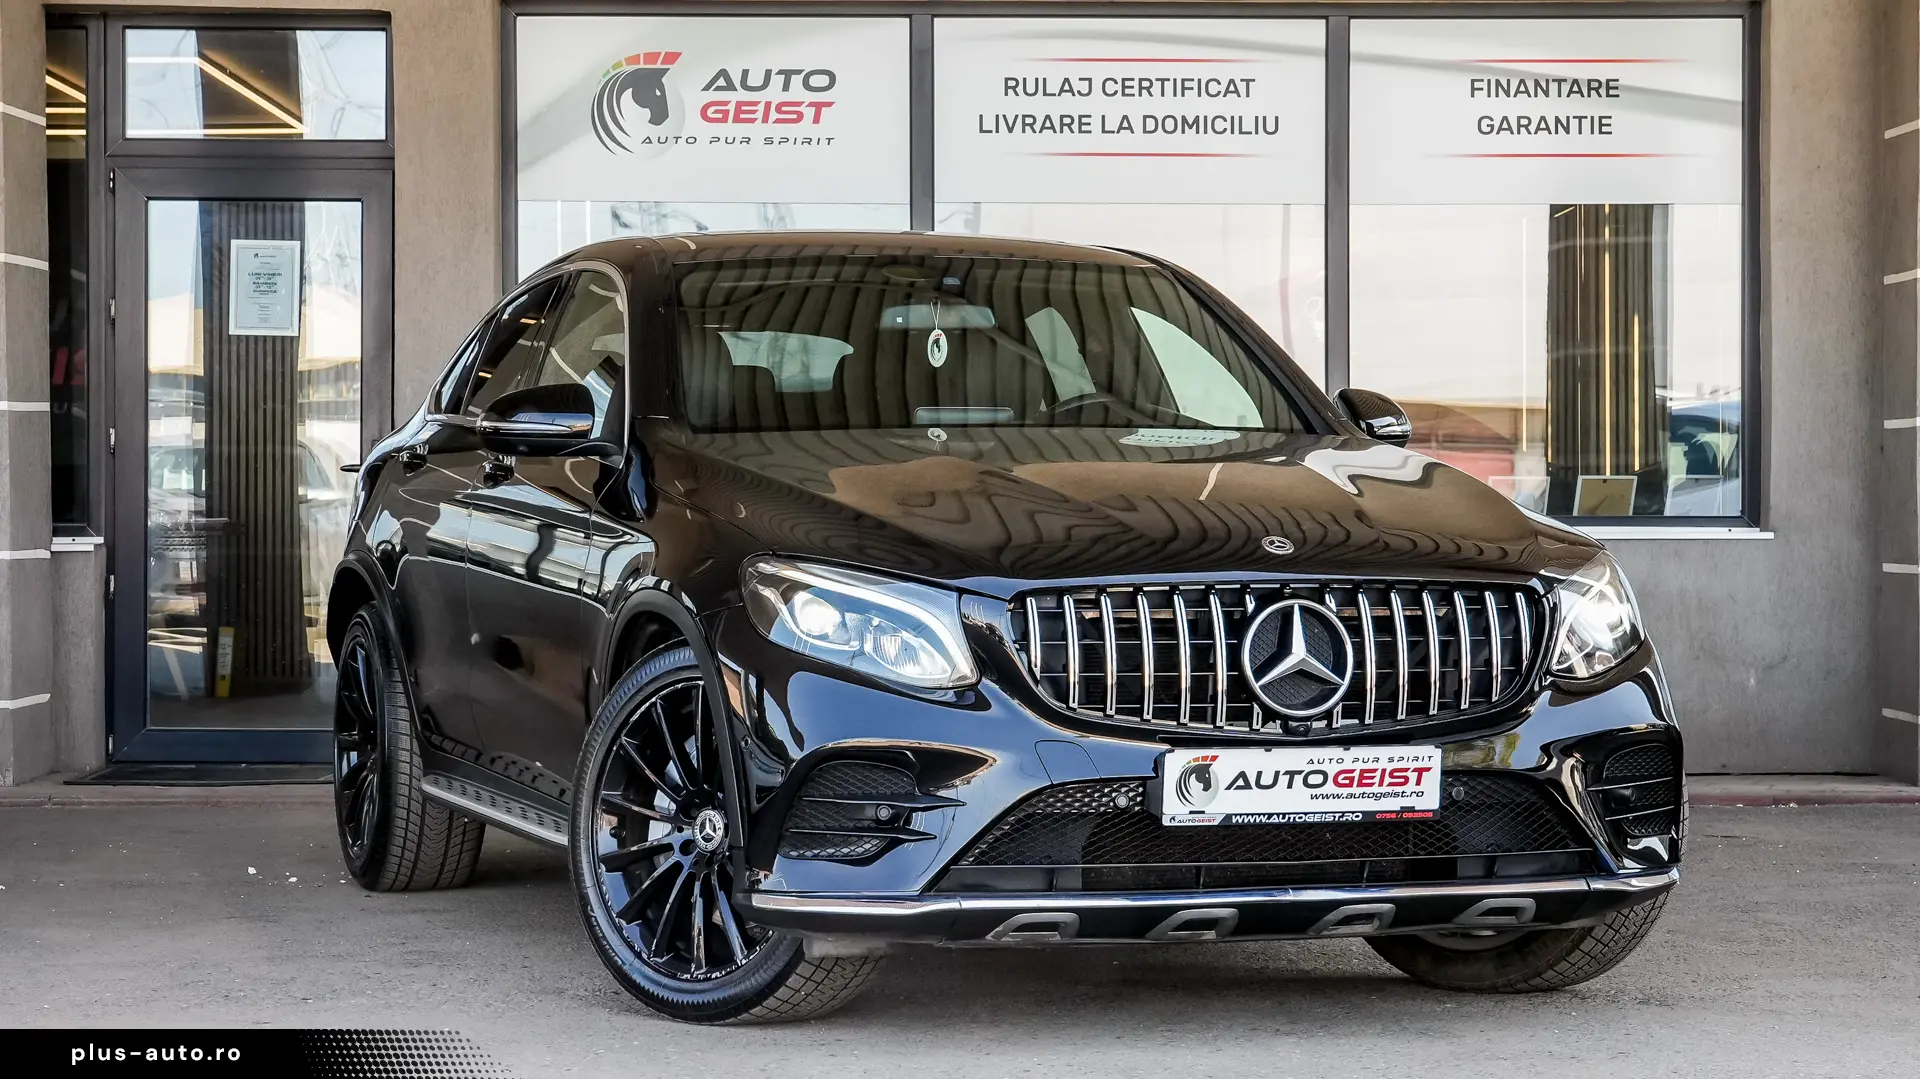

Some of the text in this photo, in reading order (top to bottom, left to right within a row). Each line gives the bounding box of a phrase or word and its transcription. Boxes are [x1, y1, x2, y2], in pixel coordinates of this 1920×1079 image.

[700, 67, 837, 93] AUTO
[1003, 76, 1256, 99] RULAJ CERTIFICAT
[1470, 78, 1620, 98] FINANTARE
[699, 100, 836, 125] GEIST
[978, 113, 1280, 136] LIVRARE LA DOMICILIU
[1477, 115, 1613, 136] GARANTIE
[640, 135, 836, 146] AUTO PUR SPIRIT
[1306, 755, 1434, 766] AUTO PUR SPIRIT
[1309, 789, 1425, 801] www.autogeist.ro
[1231, 812, 1363, 824] WWW.AUTOGEIST.RO
